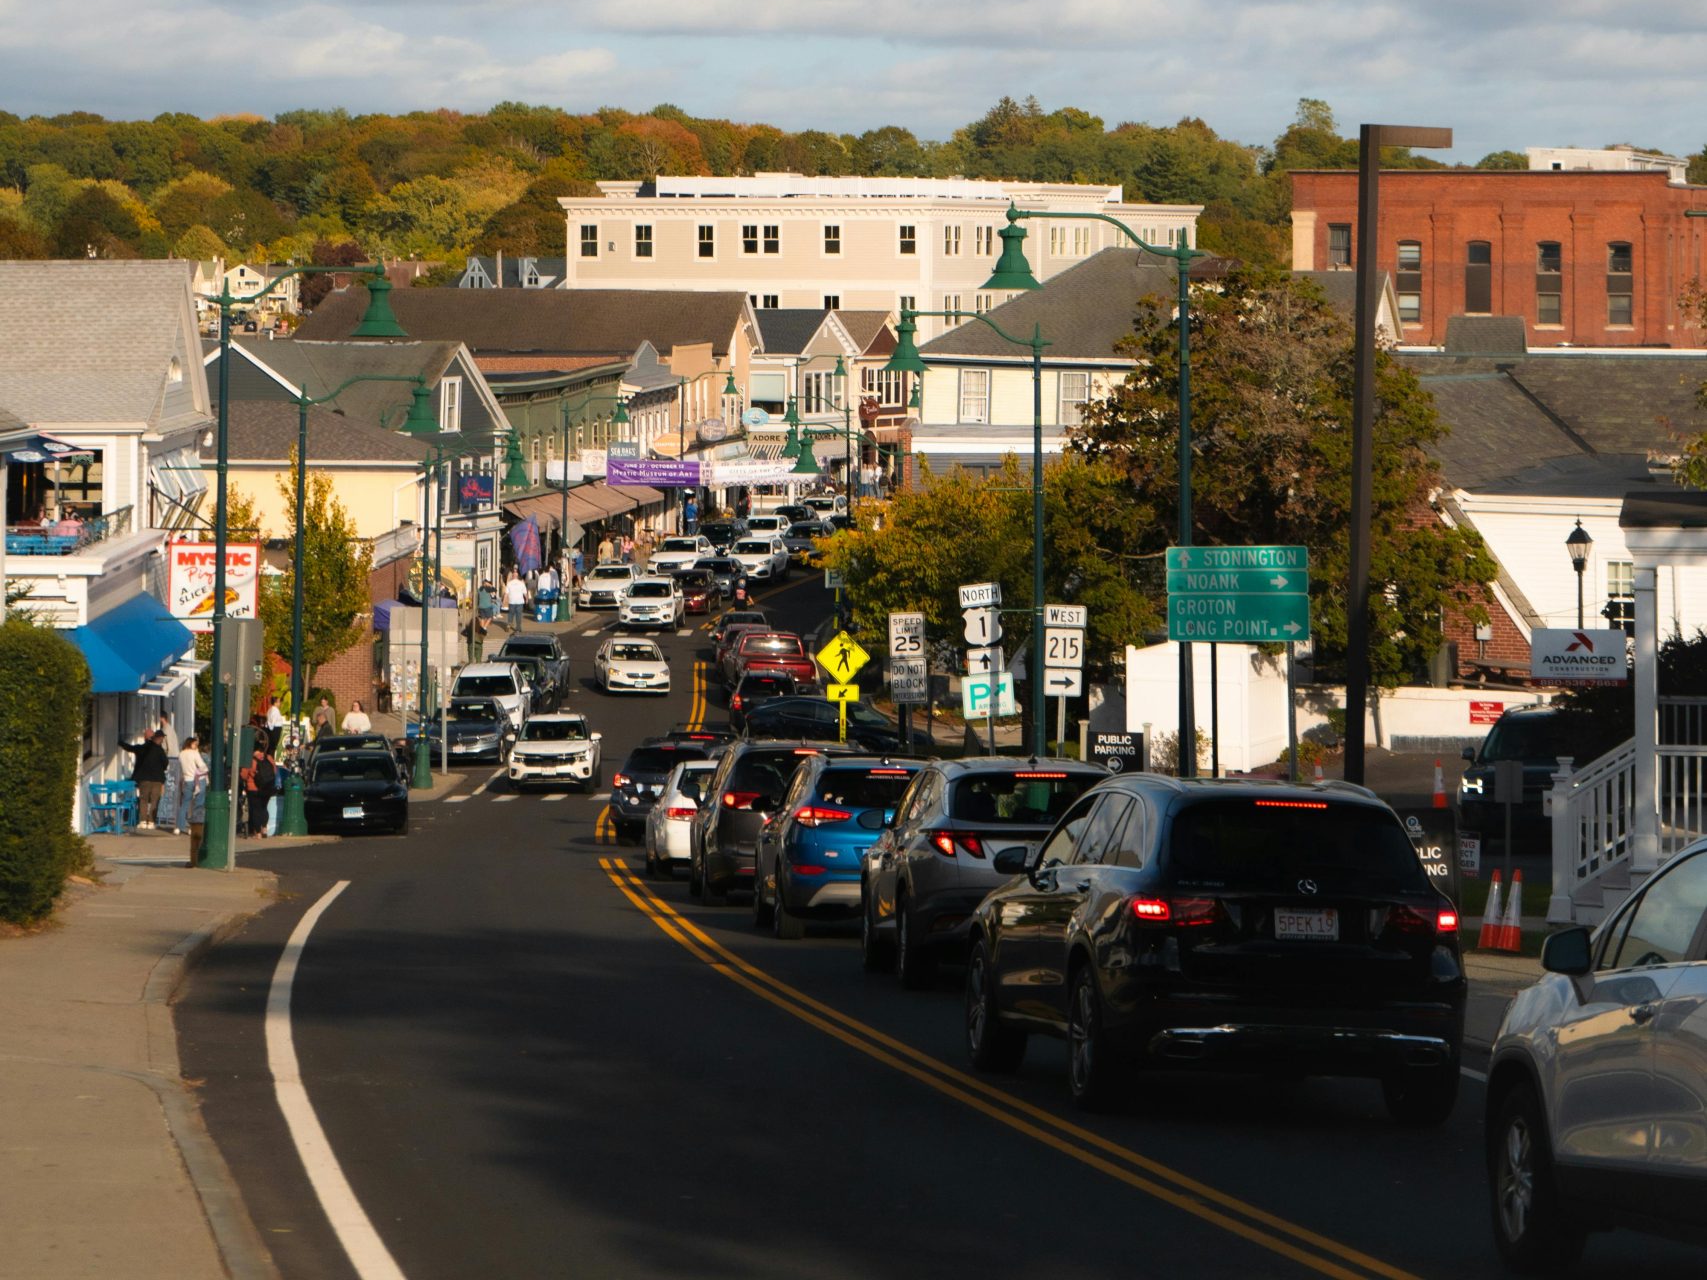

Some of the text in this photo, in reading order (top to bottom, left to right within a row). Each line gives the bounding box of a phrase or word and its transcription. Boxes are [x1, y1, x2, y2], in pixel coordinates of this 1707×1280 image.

[1203, 550, 1297, 566] STONINGTON
[1187, 574, 1240, 590] NOANK
[179, 586, 207, 606] SLICE
[181, 587, 188, 595] A
[962, 588, 998, 602] NORTH
[1176, 599, 1236, 615] GROTON
[893, 618, 922, 626] SPEED
[1050, 609, 1081, 623] WEST
[896, 626, 918, 634] LIMIT
[979, 616, 987, 638] 1
[1176, 620, 1269, 635] LONG POINT
[895, 636, 921, 652] 25
[1049, 637, 1079, 658] 215
[1542, 656, 1616, 664] ADVANCED
[894, 665, 924, 675] DO NOT
[894, 679, 924, 689] BLOCK
[1098, 734, 1132, 745] PUBLIC
[1094, 745, 1136, 755] PARKING
